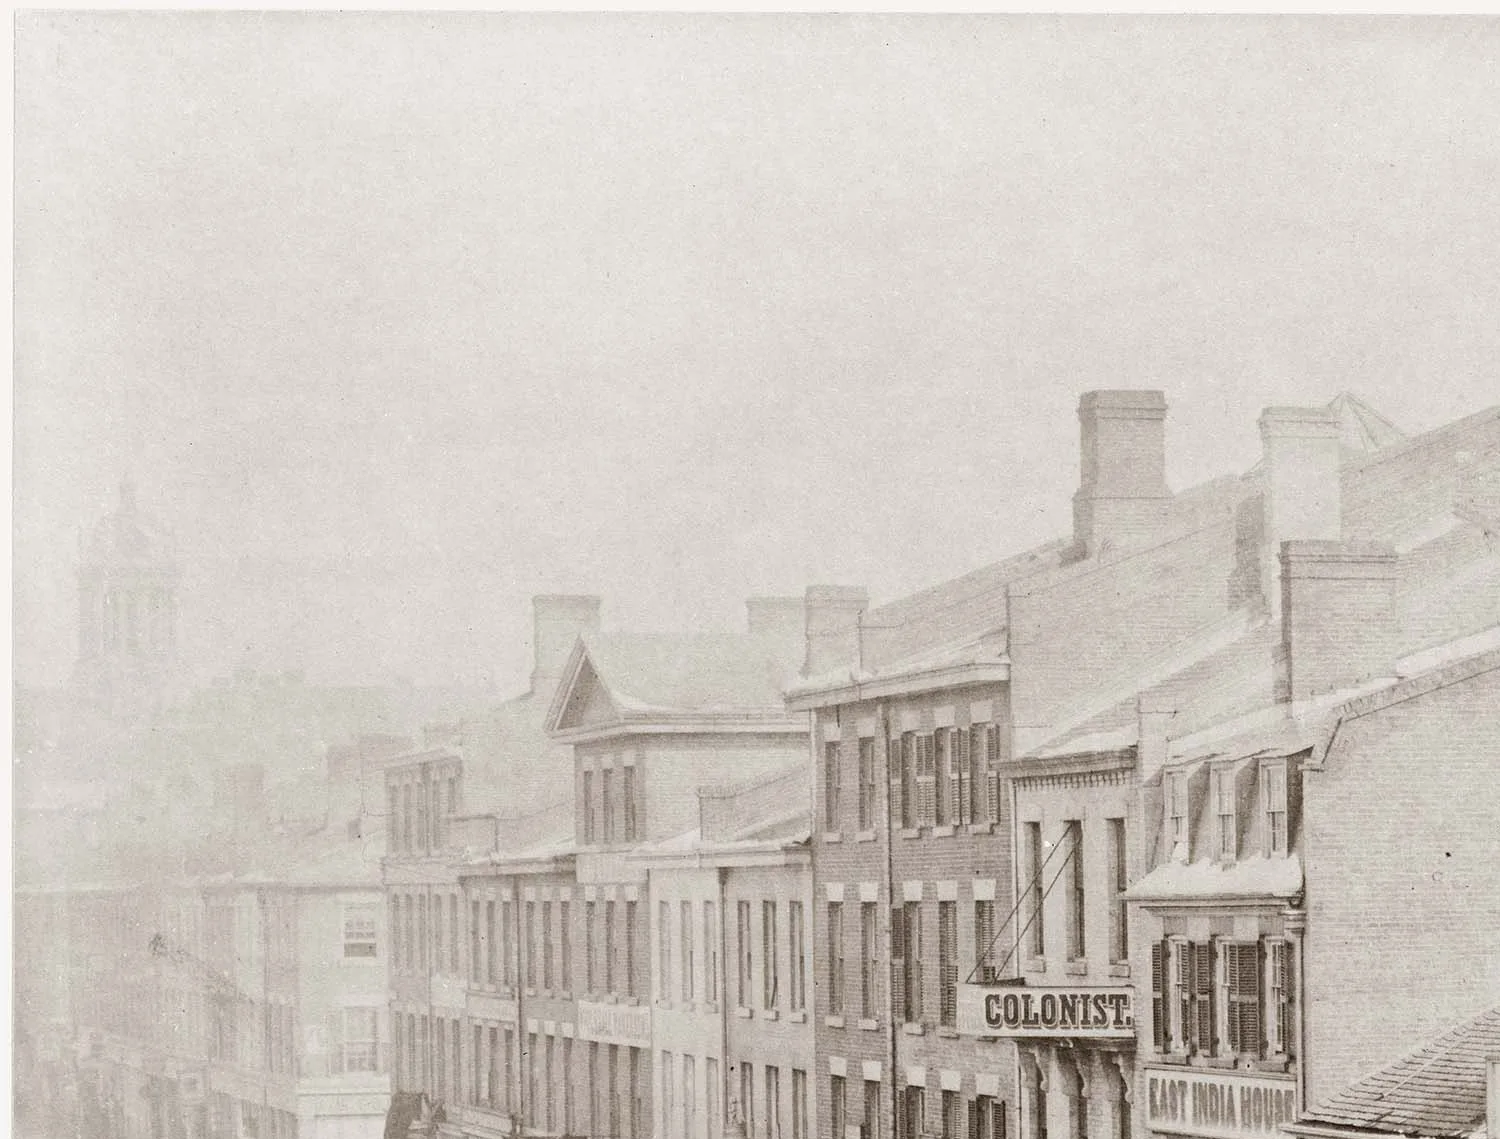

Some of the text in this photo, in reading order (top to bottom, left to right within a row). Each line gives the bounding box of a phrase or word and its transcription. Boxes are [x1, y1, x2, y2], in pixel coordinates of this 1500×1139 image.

[985, 994, 1133, 1029] COLONIST.
[1150, 1078, 1187, 1121] EAST
[1193, 1081, 1236, 1129] INDIA
